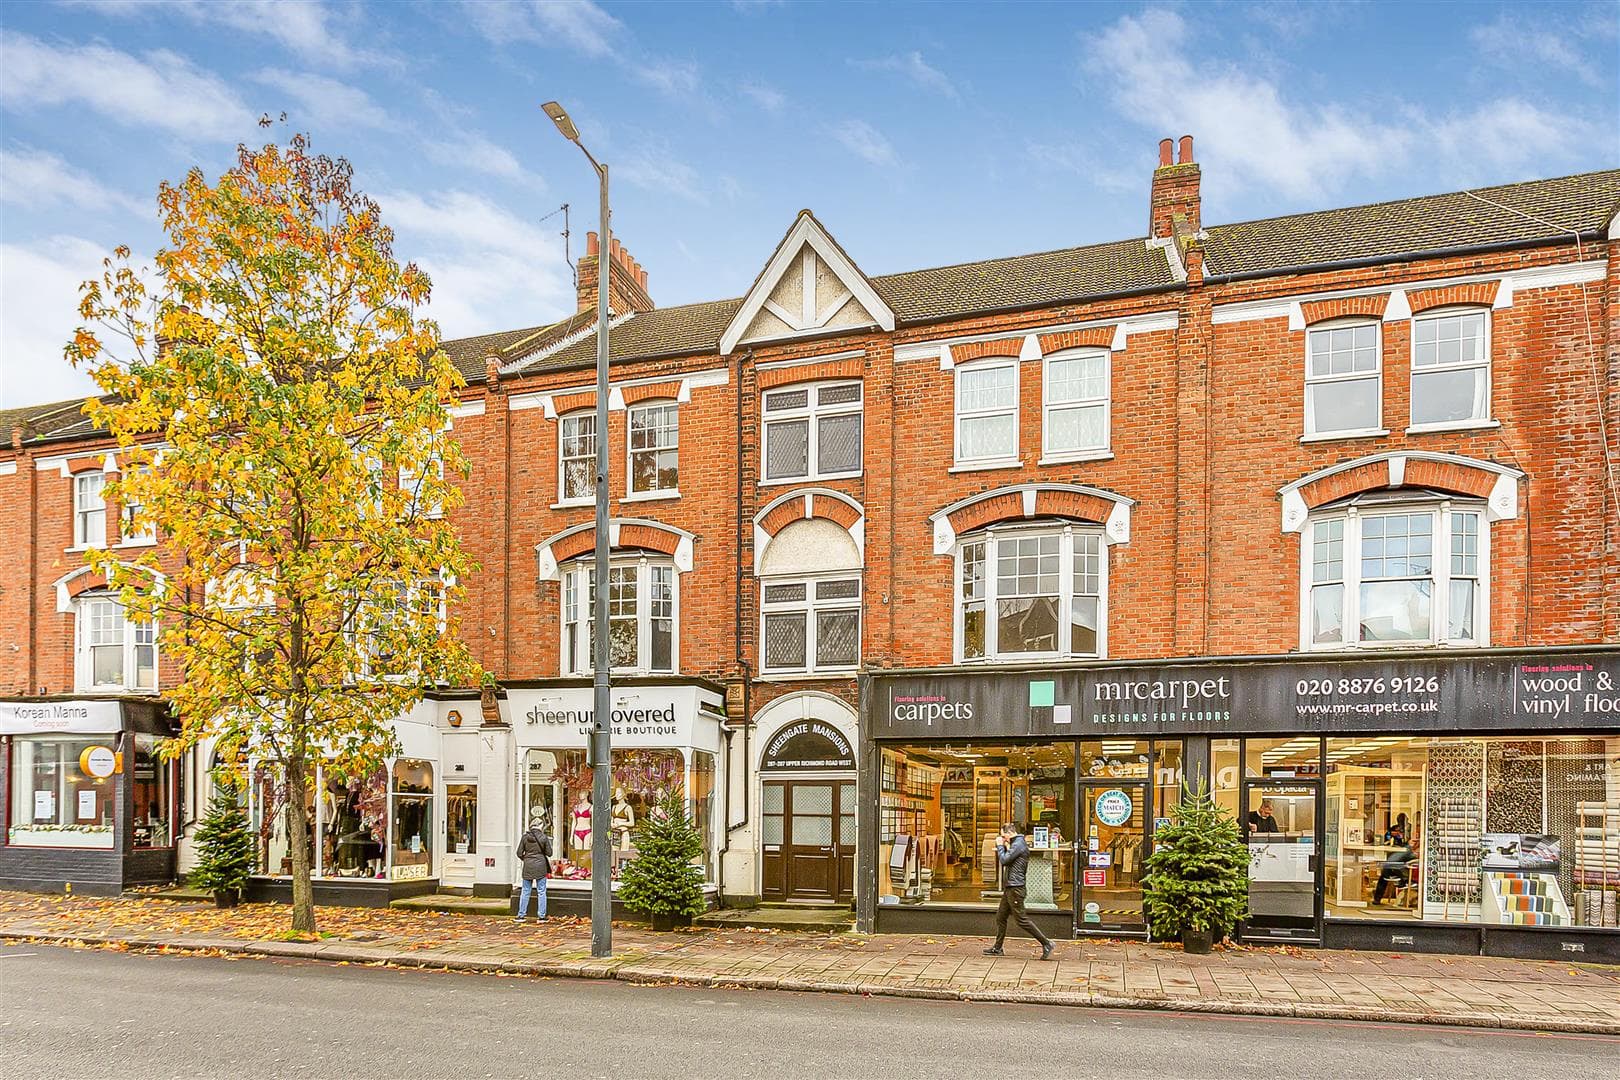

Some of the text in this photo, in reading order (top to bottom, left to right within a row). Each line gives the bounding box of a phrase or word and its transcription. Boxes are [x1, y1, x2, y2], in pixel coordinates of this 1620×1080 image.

[1521, 665, 1549, 673] Flooring
[1552, 664, 1584, 672] solutions
[1296, 676, 1439, 696] 020 8876 9126
[1522, 671, 1614, 693] wood &
[1094, 675, 1231, 709] mrcarpet
[13, 705, 88, 719] Korean Manna
[526, 702, 676, 725] sheenuovered
[894, 700, 973, 726] carpets
[1295, 699, 1439, 716] www.mr-carpet.co.uk
[1522, 693, 1570, 720] vinyl
[33, 720, 55, 729] Coming
[1093, 711, 1231, 723] DESIGNS FOR FLOORS
[579, 726, 677, 735] LINRIE BOUTIQUE
[768, 723, 850, 757] SHEENGATE MANSIONS
[838, 759, 852, 767] WEST
